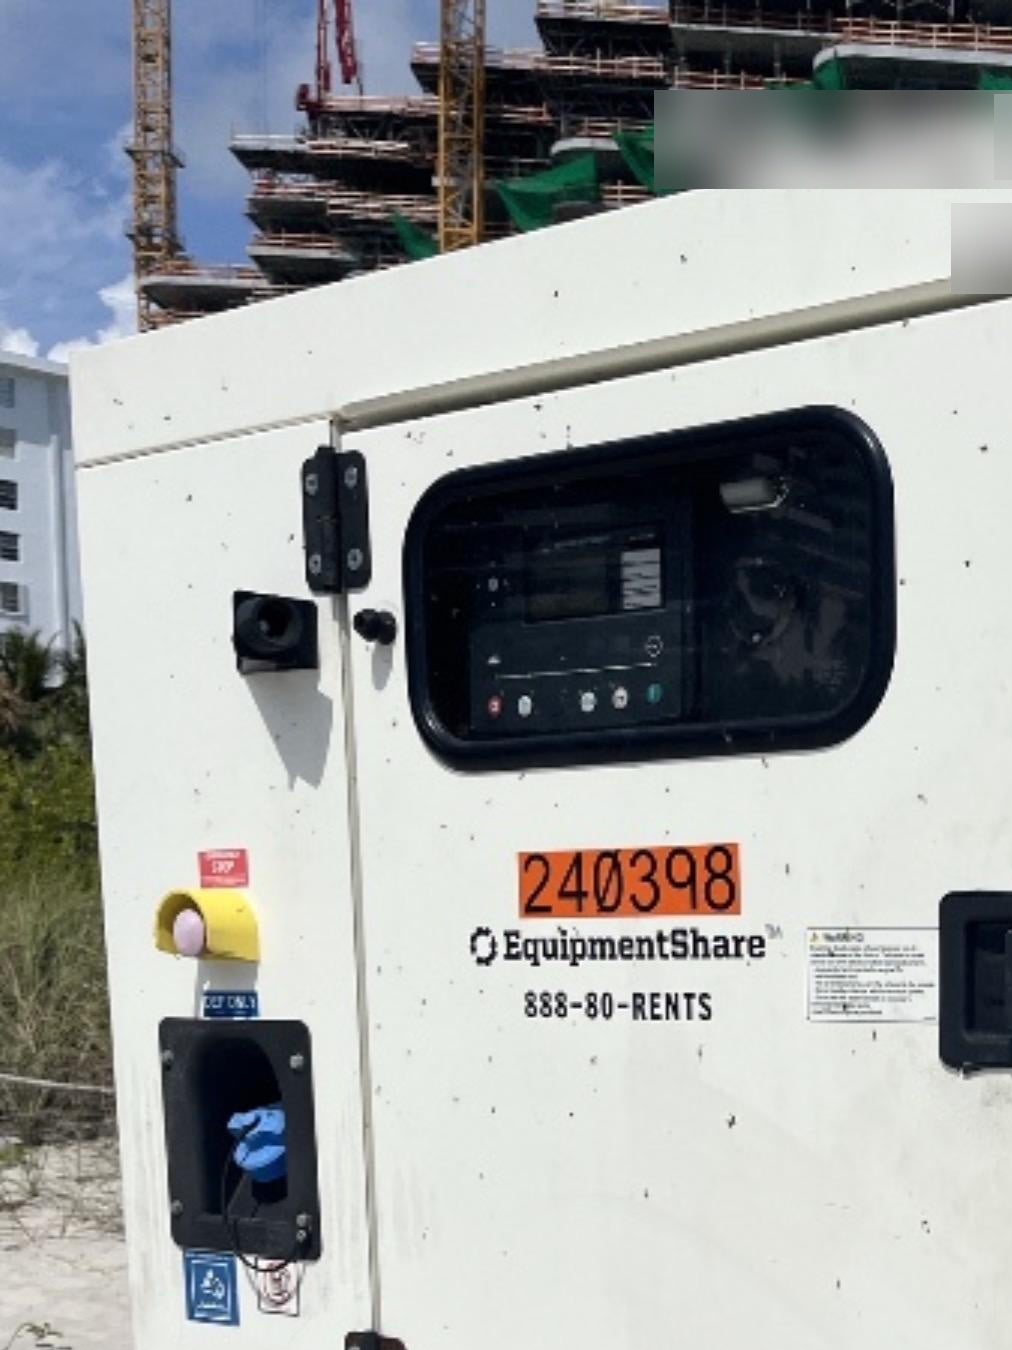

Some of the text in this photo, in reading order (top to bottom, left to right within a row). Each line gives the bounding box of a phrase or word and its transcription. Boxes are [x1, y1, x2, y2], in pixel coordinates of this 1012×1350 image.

[522, 845, 736, 914] 240398
[503, 926, 766, 966] EquipmentShare
[523, 991, 713, 1022] 888-80-RENTS
